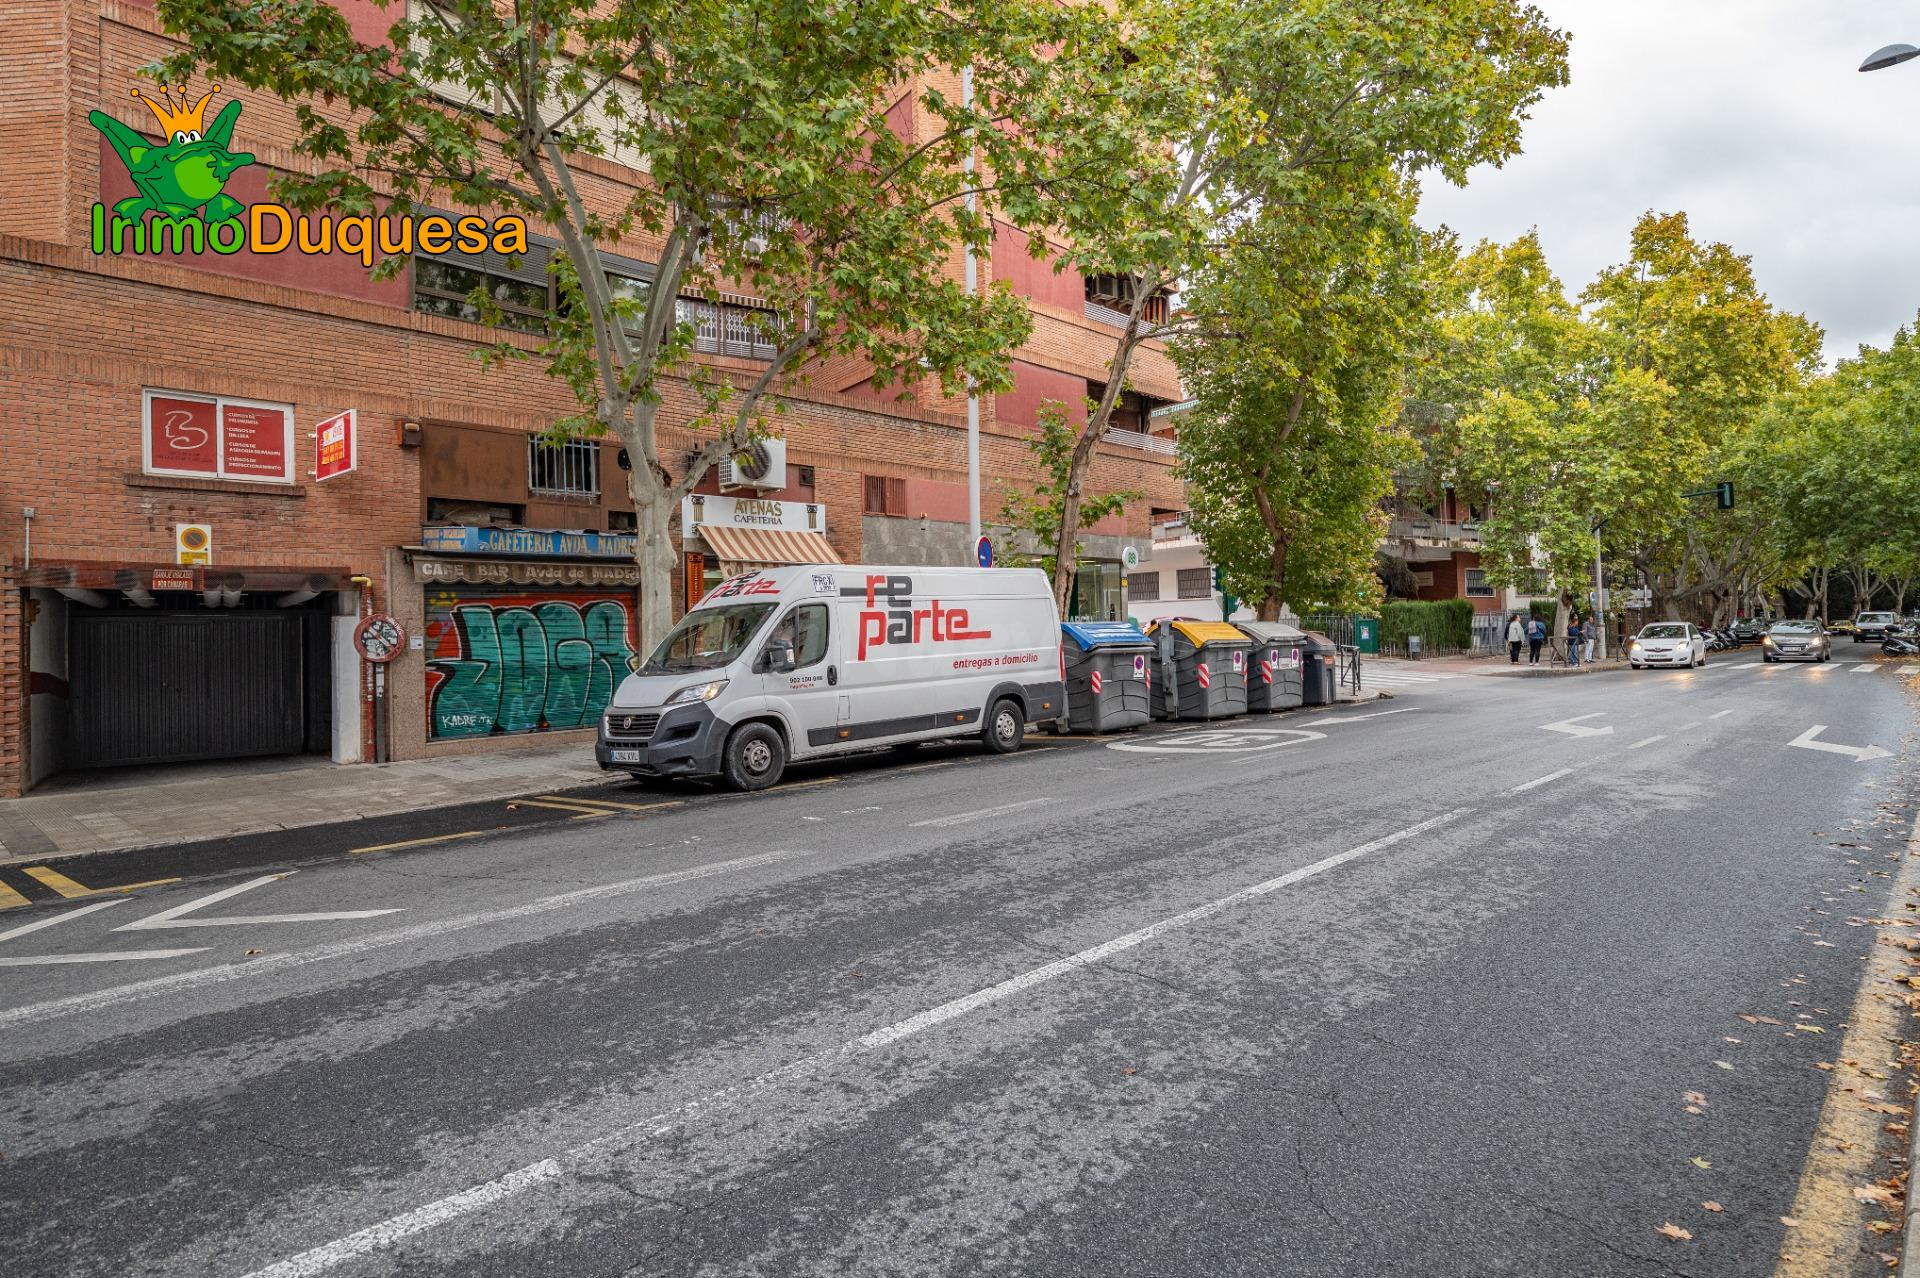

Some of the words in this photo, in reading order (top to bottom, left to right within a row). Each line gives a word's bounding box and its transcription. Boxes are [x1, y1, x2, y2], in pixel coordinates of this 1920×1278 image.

[734, 499, 783, 516] ATENAS
[478, 564, 510, 578] BAR
[855, 575, 913, 608] re
[857, 600, 992, 662] parte
[953, 658, 992, 669] entregas
[994, 658, 1000, 666] a
[1002, 653, 1038, 665] domicilio
